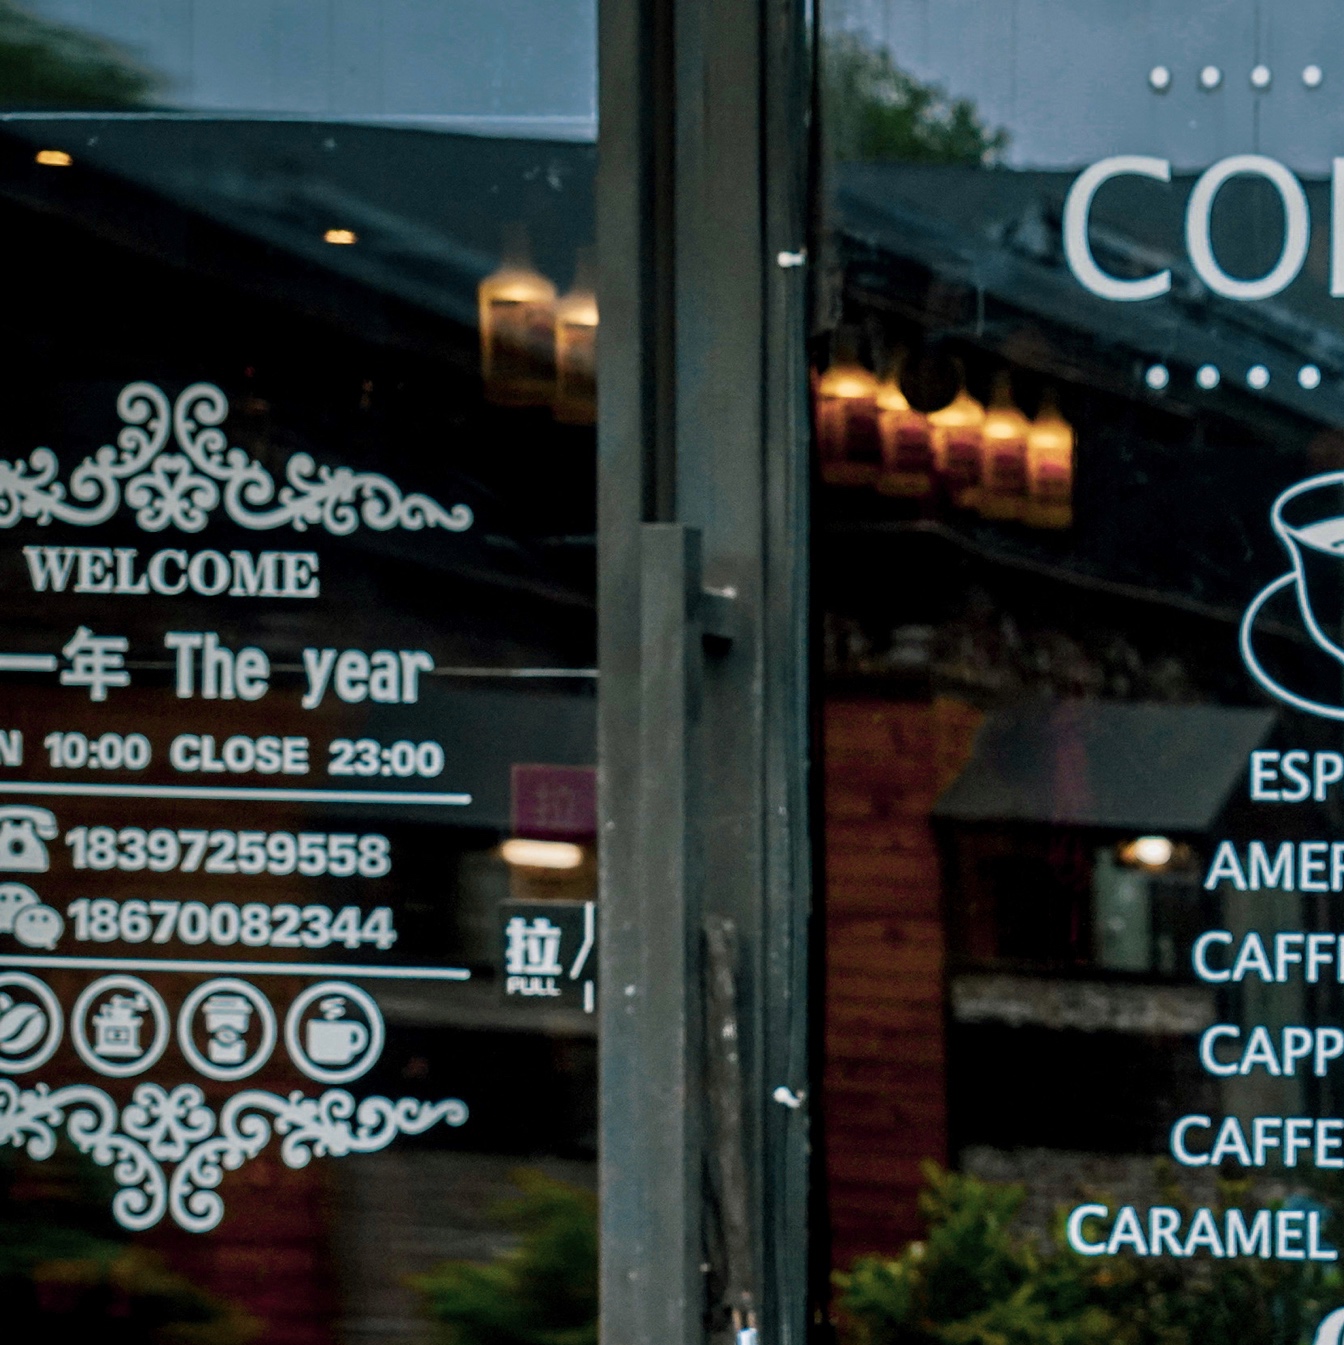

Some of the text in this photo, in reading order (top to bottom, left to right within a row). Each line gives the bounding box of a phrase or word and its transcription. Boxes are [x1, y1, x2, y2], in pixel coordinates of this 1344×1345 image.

[22, 546, 320, 598] WELCOME
[164, 631, 271, 700] The
[301, 647, 435, 710] year
[43, 732, 152, 770] 10:00
[169, 734, 310, 774] CLOSE
[327, 739, 445, 778] 23:00
[65, 826, 391, 878] 18397259558
[67, 900, 397, 950] 18670082344
[505, 917, 563, 976] 拉
[506, 976, 562, 997] PULL
[1066, 1203, 1338, 1261] CARAMEL
